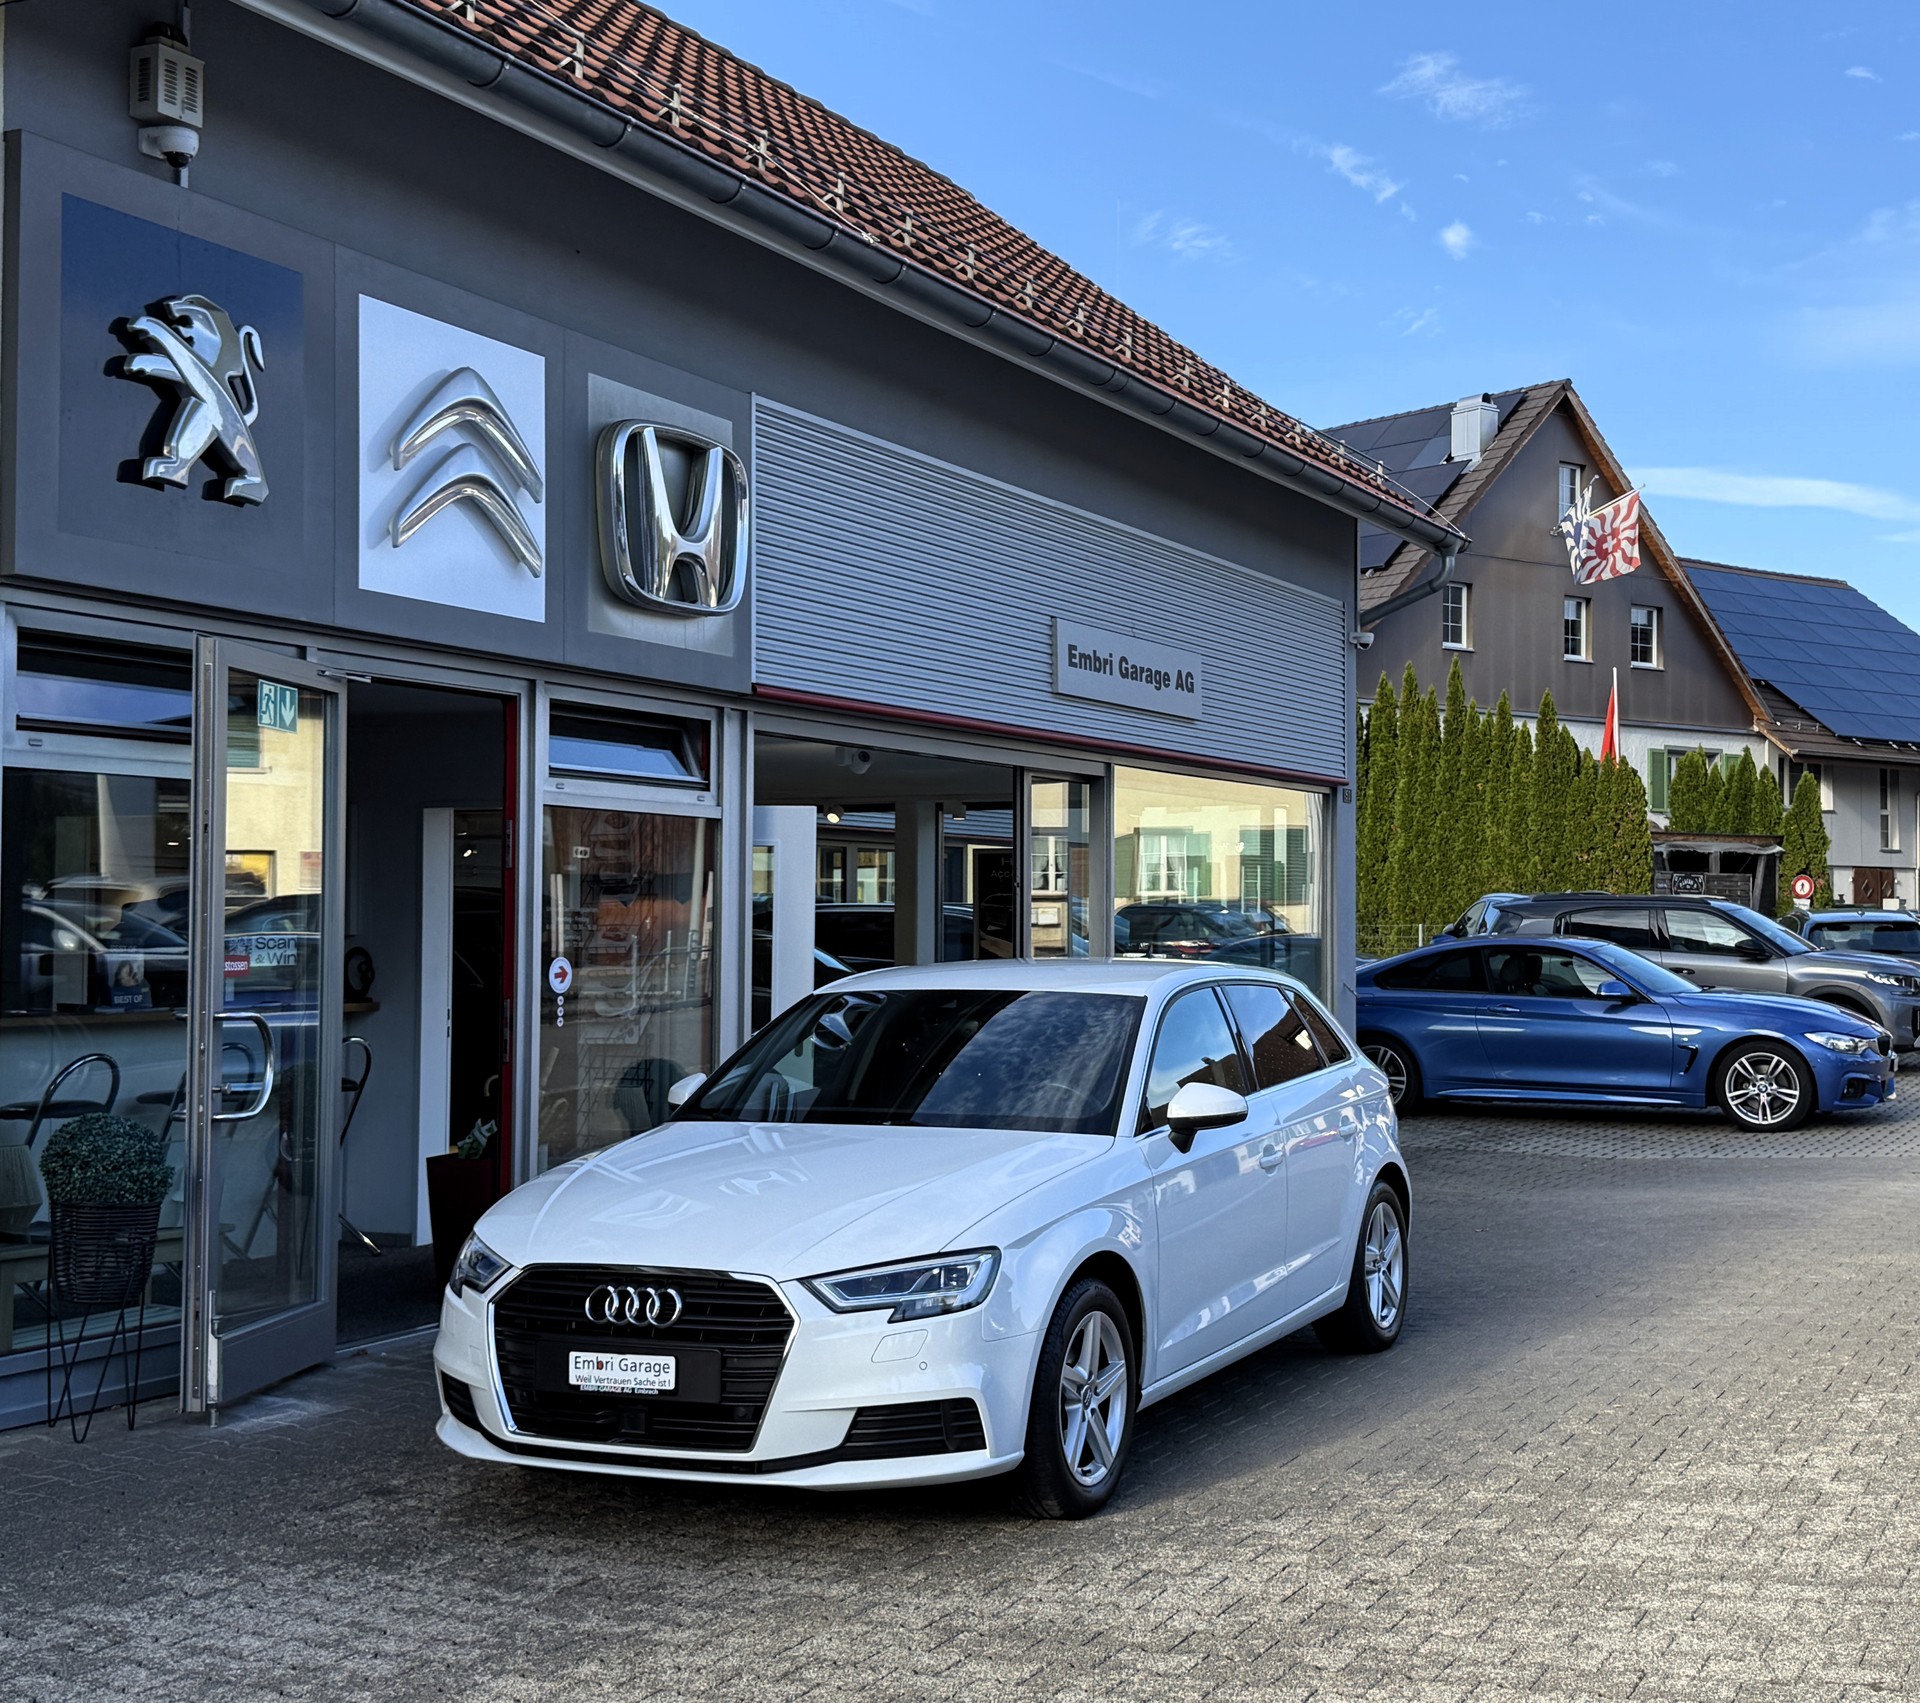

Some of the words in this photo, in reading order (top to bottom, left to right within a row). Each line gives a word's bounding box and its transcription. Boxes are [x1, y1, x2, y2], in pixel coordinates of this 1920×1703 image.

[1067, 643, 1114, 676] Embri
[1118, 655, 1171, 691] Garage
[1174, 669, 1195, 694] AG
[255, 937, 297, 950] Scan
[267, 950, 297, 964] Win
[224, 960, 248, 971] stossen
[113, 994, 132, 1004] BEST
[133, 994, 143, 1003] OF
[574, 1355, 614, 1371] Embri
[618, 1357, 671, 1377] Garage
[575, 1374, 592, 1383] Weil
[594, 1375, 632, 1386] Vertrauen
[633, 1377, 656, 1387] Sache
[658, 1379, 667, 1387] ist
[634, 1387, 659, 1395] Embrach
